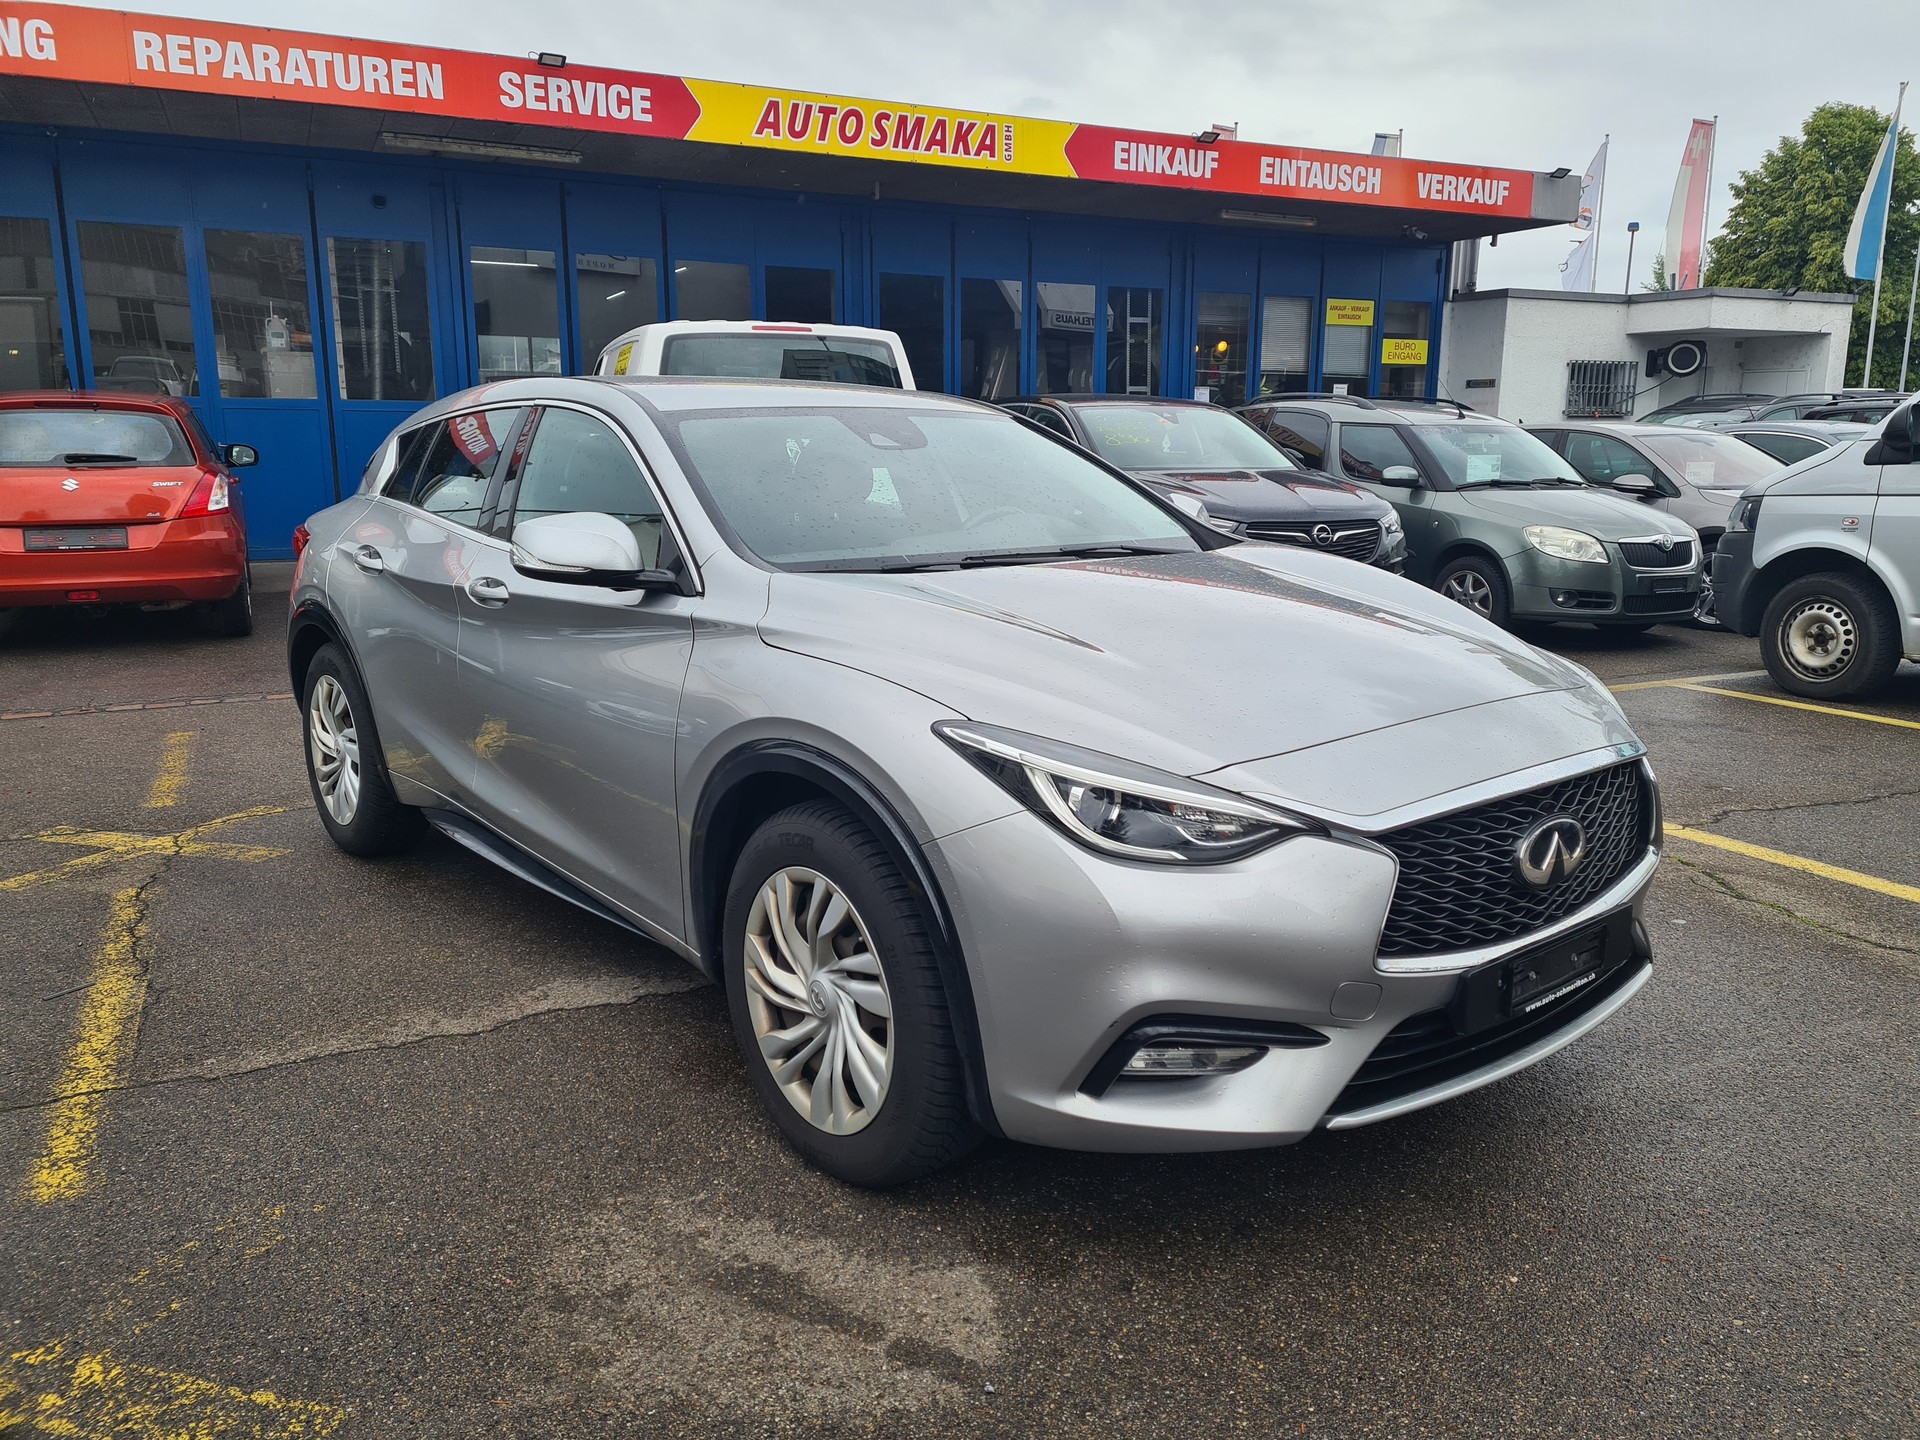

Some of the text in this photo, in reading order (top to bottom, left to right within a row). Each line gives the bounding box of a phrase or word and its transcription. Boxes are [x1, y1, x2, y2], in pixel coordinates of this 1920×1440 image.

[132, 30, 445, 100] REPARATUREN
[498, 71, 653, 122] SERVICE
[752, 96, 1014, 163] AUTO SMAKA GMBH
[1113, 139, 1219, 179] EINKAUF
[1259, 156, 1382, 195] EINTAUSCH
[1417, 172, 1511, 206] VERKAUF
[1387, 352, 1422, 361] EINGANG
[1394, 341, 1416, 351] BÜRO
